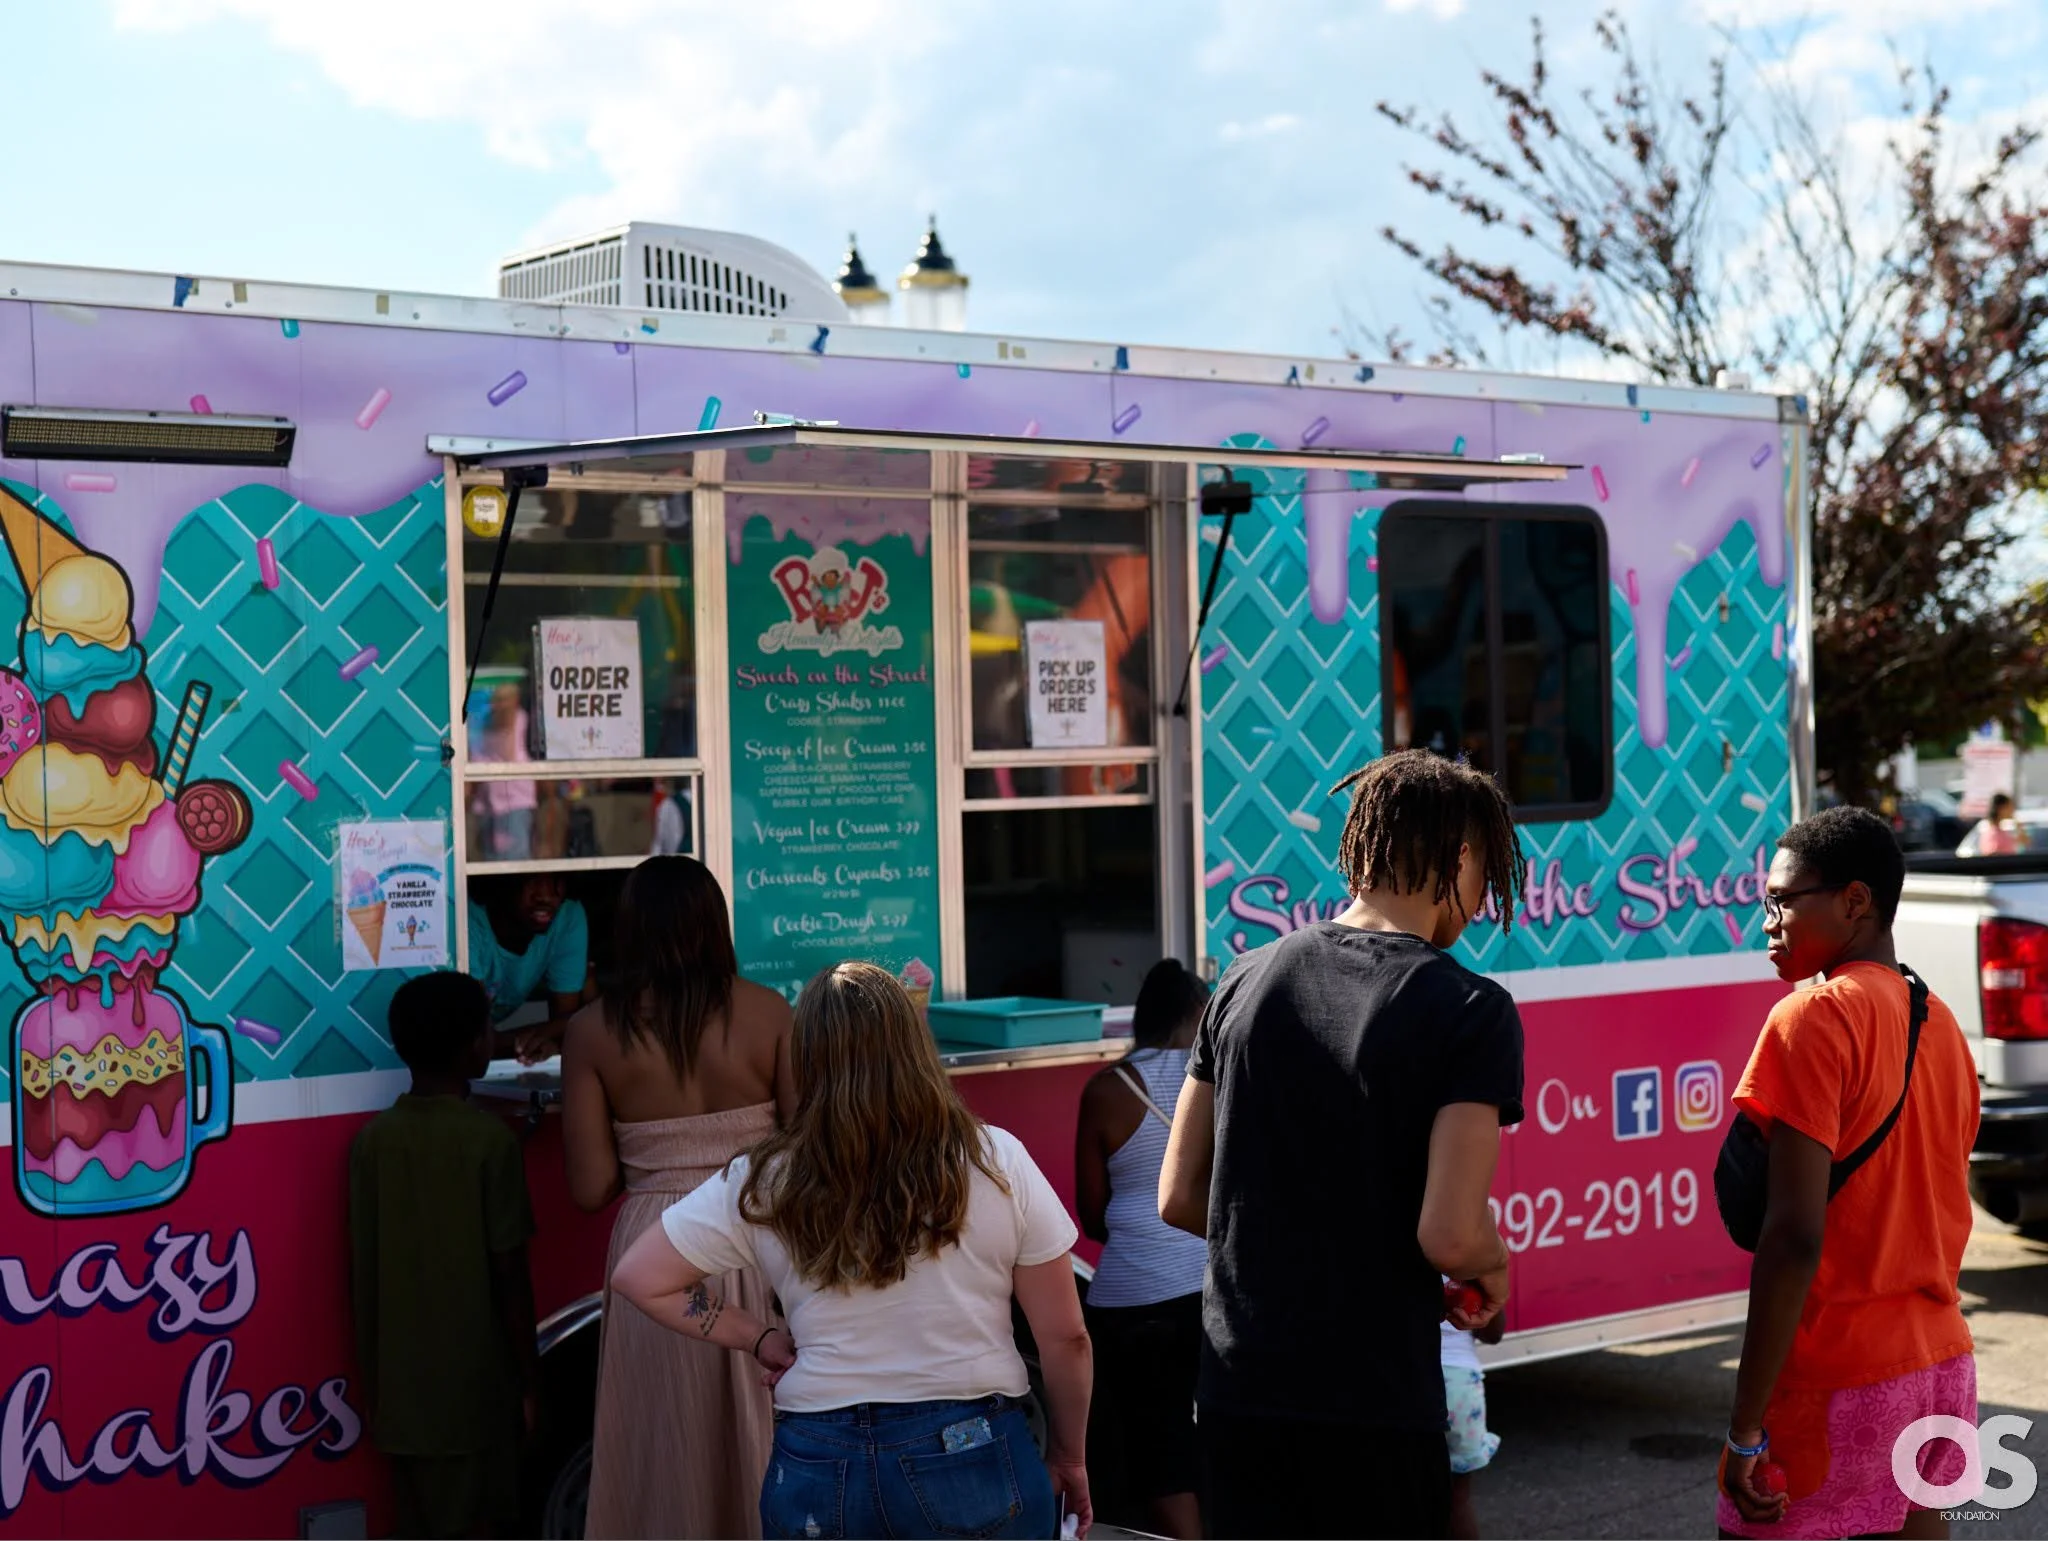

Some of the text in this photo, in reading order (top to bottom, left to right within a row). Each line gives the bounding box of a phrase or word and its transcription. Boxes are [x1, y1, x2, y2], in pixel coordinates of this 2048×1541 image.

[550, 666, 630, 691] ORDER
[736, 663, 928, 690] Sweets on the Street
[1038, 660, 1096, 676] PICK UP
[1038, 678, 1096, 695] ORDERS
[557, 693, 622, 718] HERE
[765, 692, 810, 714] Crazy
[815, 690, 872, 712] Shakes
[1047, 697, 1087, 714] HERE
[744, 739, 795, 761] Scoop
[844, 738, 897, 759] Cream
[838, 783, 892, 794] CHOCOLATE
[753, 820, 804, 845] Vegan
[810, 818, 830, 842] Ice
[837, 818, 890, 840] Cream
[397, 880, 427, 890] VANILLA
[835, 862, 901, 886] Cupcakes
[388, 890, 436, 901] STRAWBERRY
[1525, 855, 1600, 927] the
[1617, 844, 1769, 929] Street
[390, 900, 434, 910] CHOCOLATE
[773, 913, 823, 937] Cookie
[822, 910, 877, 933] Dough
[792, 936, 844, 949] CHOCOLATE
[743, 961, 773, 972] WATER
[1536, 1078, 1602, 1135] On
[0, 1222, 260, 1340] razy
[0, 1338, 362, 1514] hakes
